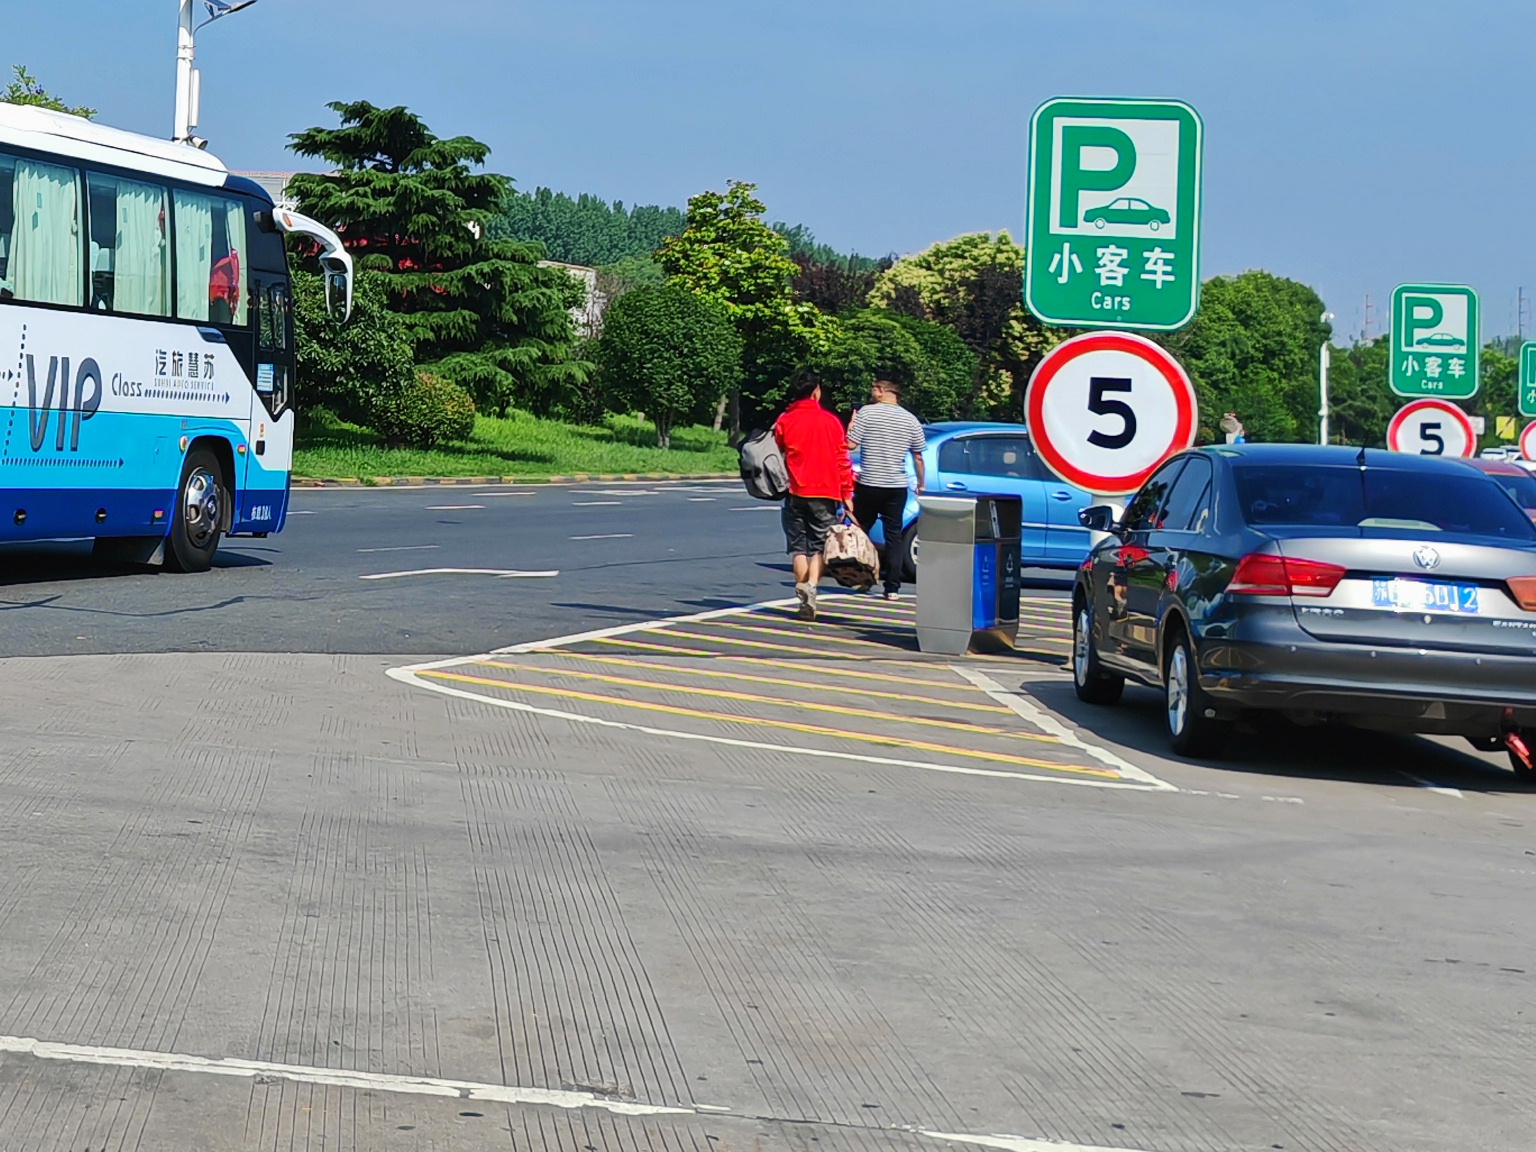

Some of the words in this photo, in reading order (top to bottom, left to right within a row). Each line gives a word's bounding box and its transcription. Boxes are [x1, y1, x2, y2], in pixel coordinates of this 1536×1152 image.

[1059, 124, 1137, 229] P
[1048, 242, 1177, 290] 小客车
[1090, 291, 1131, 311] Cars
[1405, 296, 1444, 348] P
[111, 373, 143, 397] Class
[1401, 354, 1466, 379] 小客车
[1420, 378, 1444, 390] Cars
[26, 353, 103, 453] VIP
[1086, 376, 1137, 449] 5
[1419, 422, 1445, 455] 5
